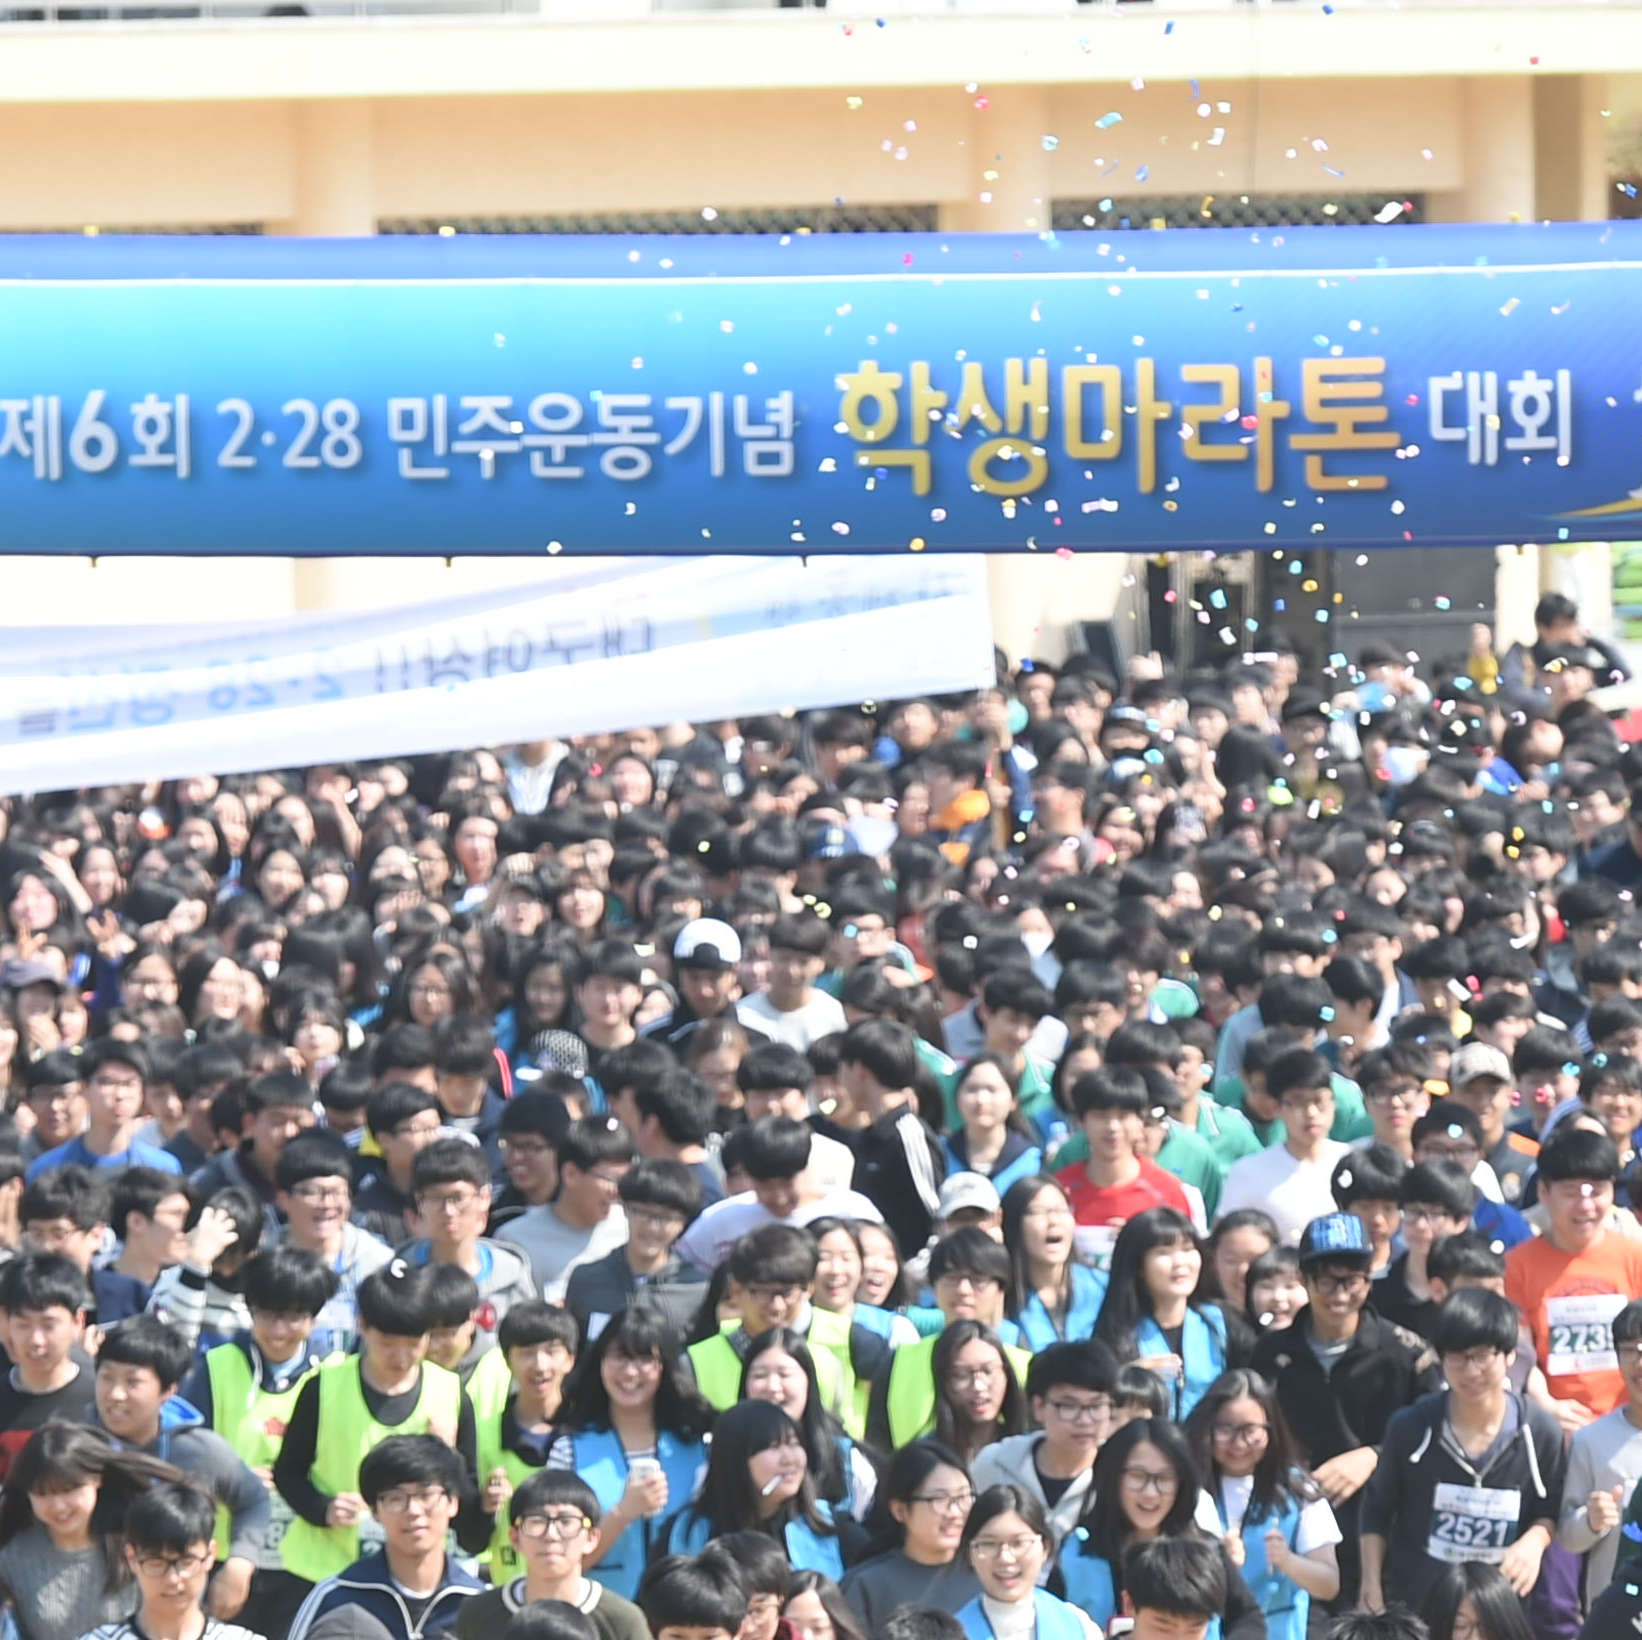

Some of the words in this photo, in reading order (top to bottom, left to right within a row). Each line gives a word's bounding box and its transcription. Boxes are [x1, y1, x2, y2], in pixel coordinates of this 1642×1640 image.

[388, 392, 797, 482] 민주운동기념
[834, 354, 1403, 499] 학생마라톤
[1427, 368, 1571, 466] 대회
[1552, 1324, 1613, 1353] 273
[1437, 1512, 1508, 1549] 2521
